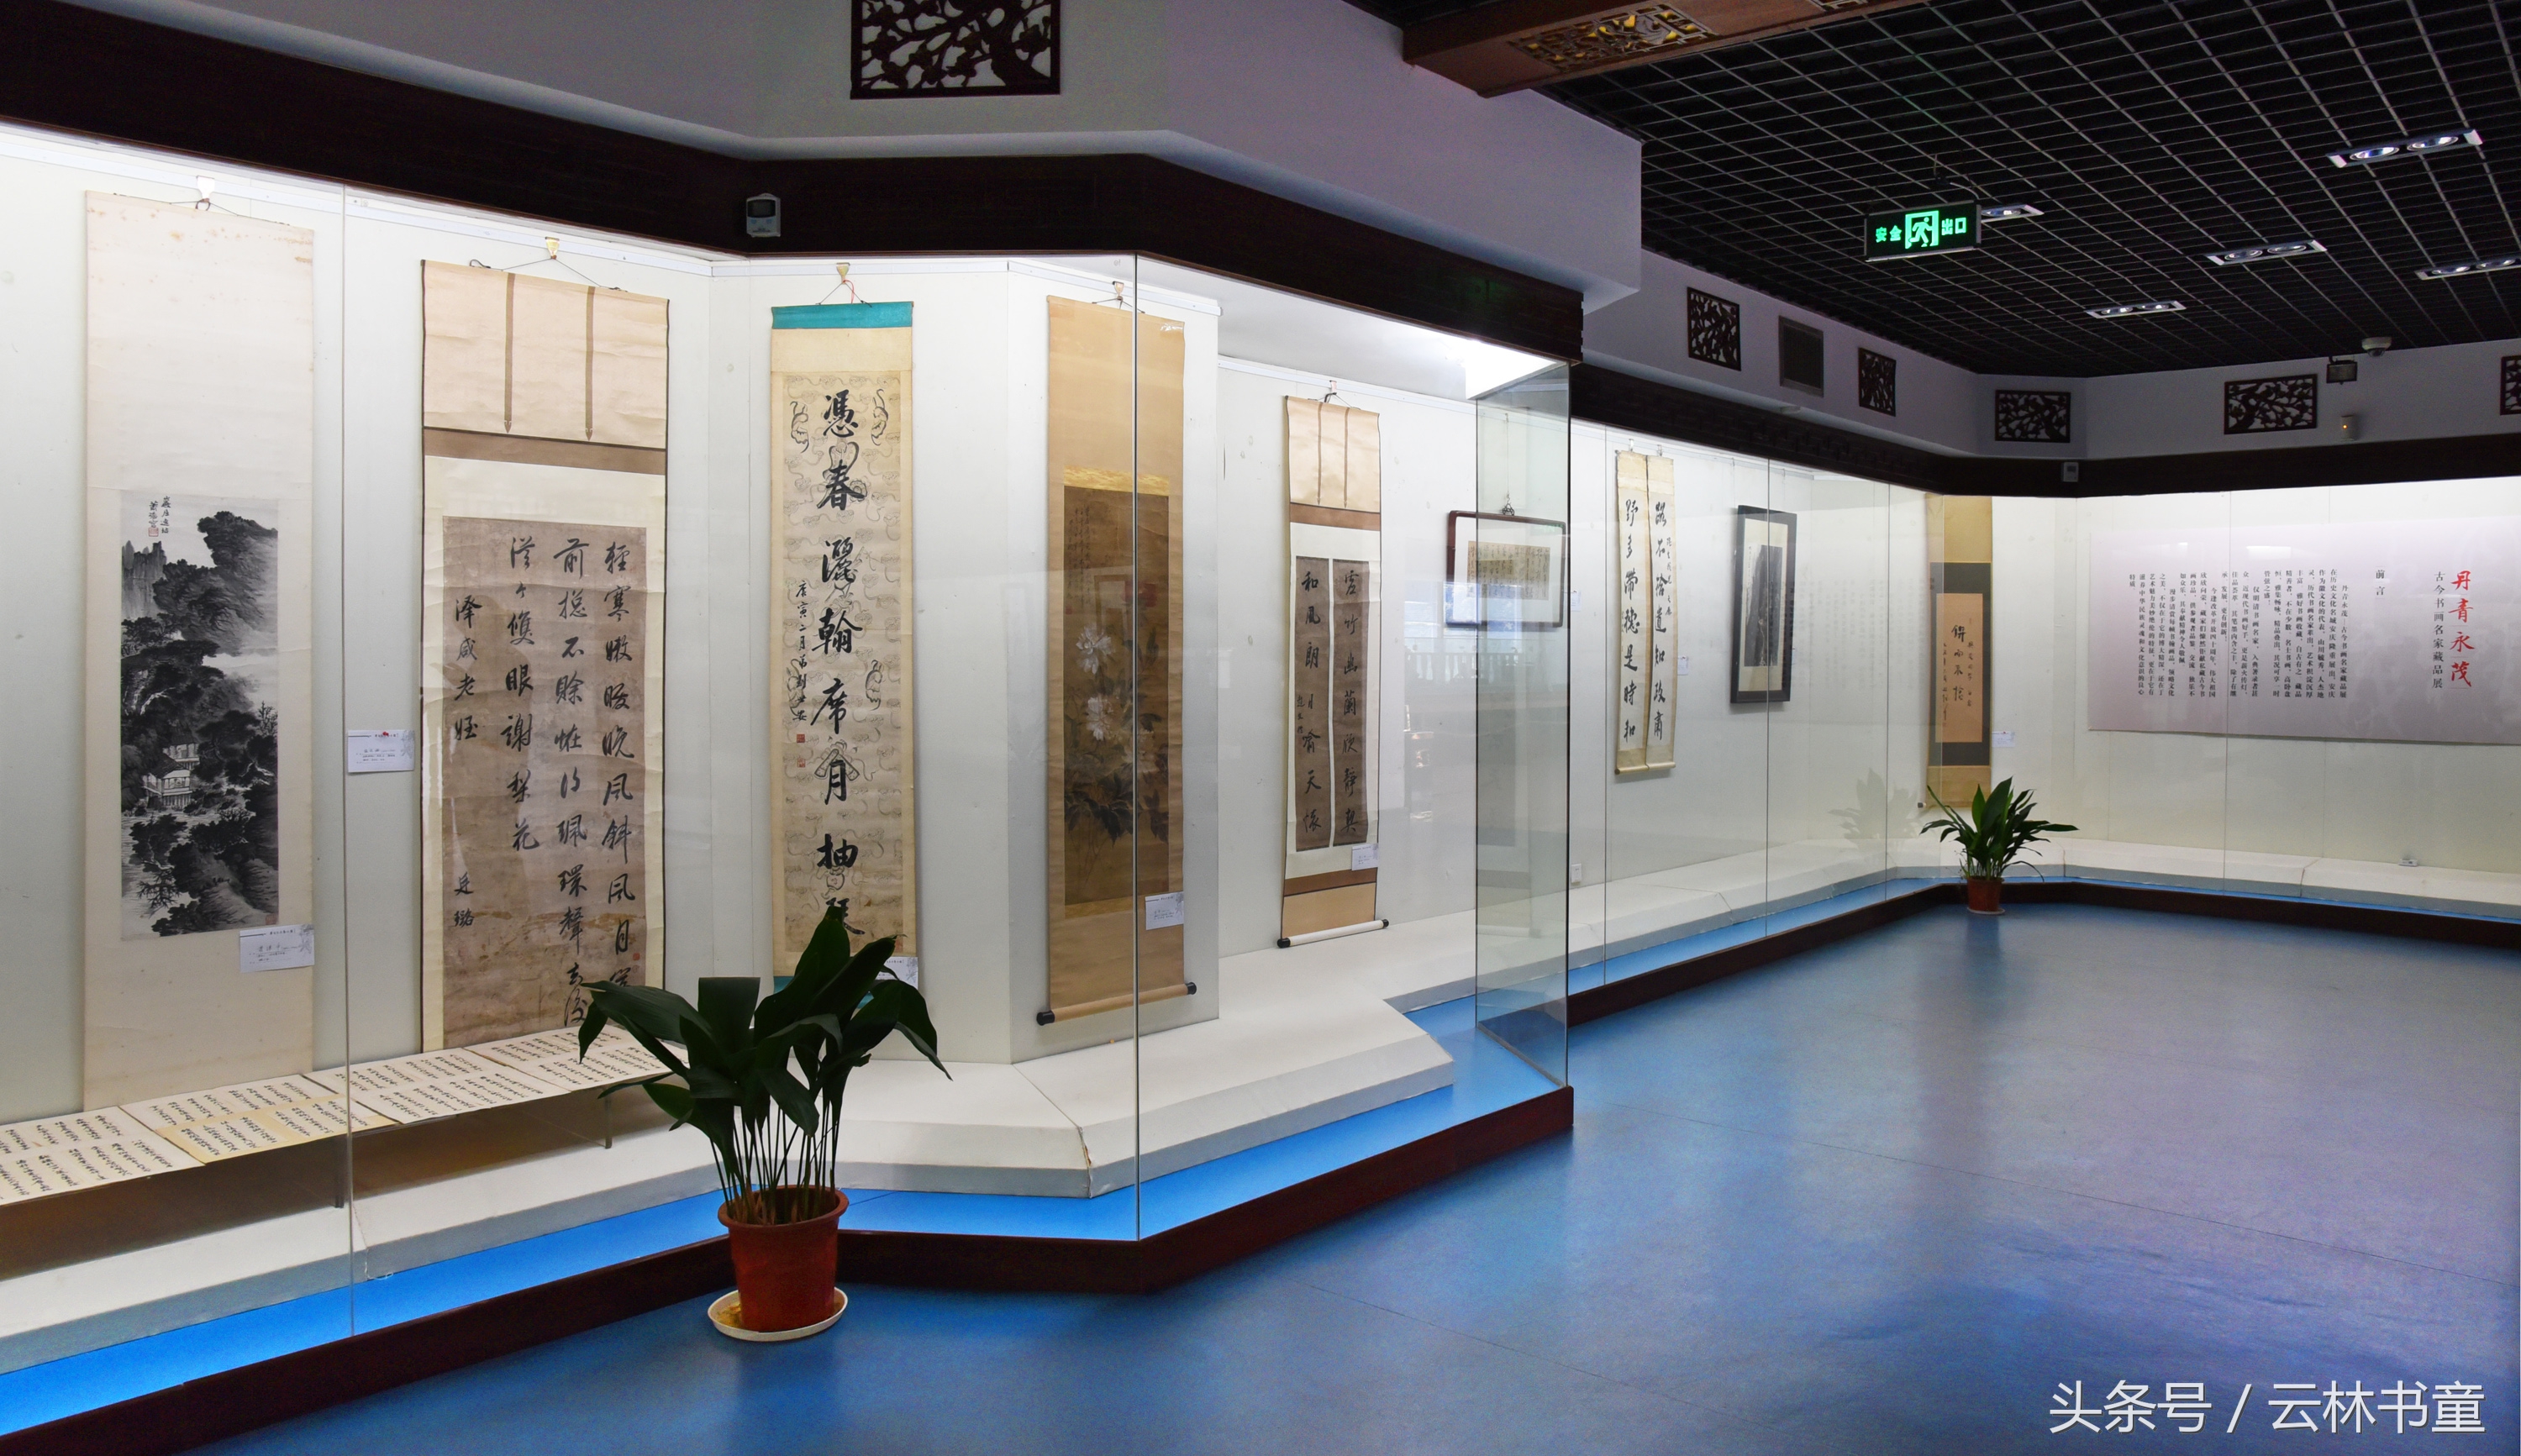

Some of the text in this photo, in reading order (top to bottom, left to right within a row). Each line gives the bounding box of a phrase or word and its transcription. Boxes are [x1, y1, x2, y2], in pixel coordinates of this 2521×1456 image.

[1875, 217, 1967, 243] 安全 出口
[2376, 569, 2385, 596] 前言
[2432, 571, 2445, 688] 古今书画名家藏品展
[2449, 570, 2475, 687] 丹青永茂
